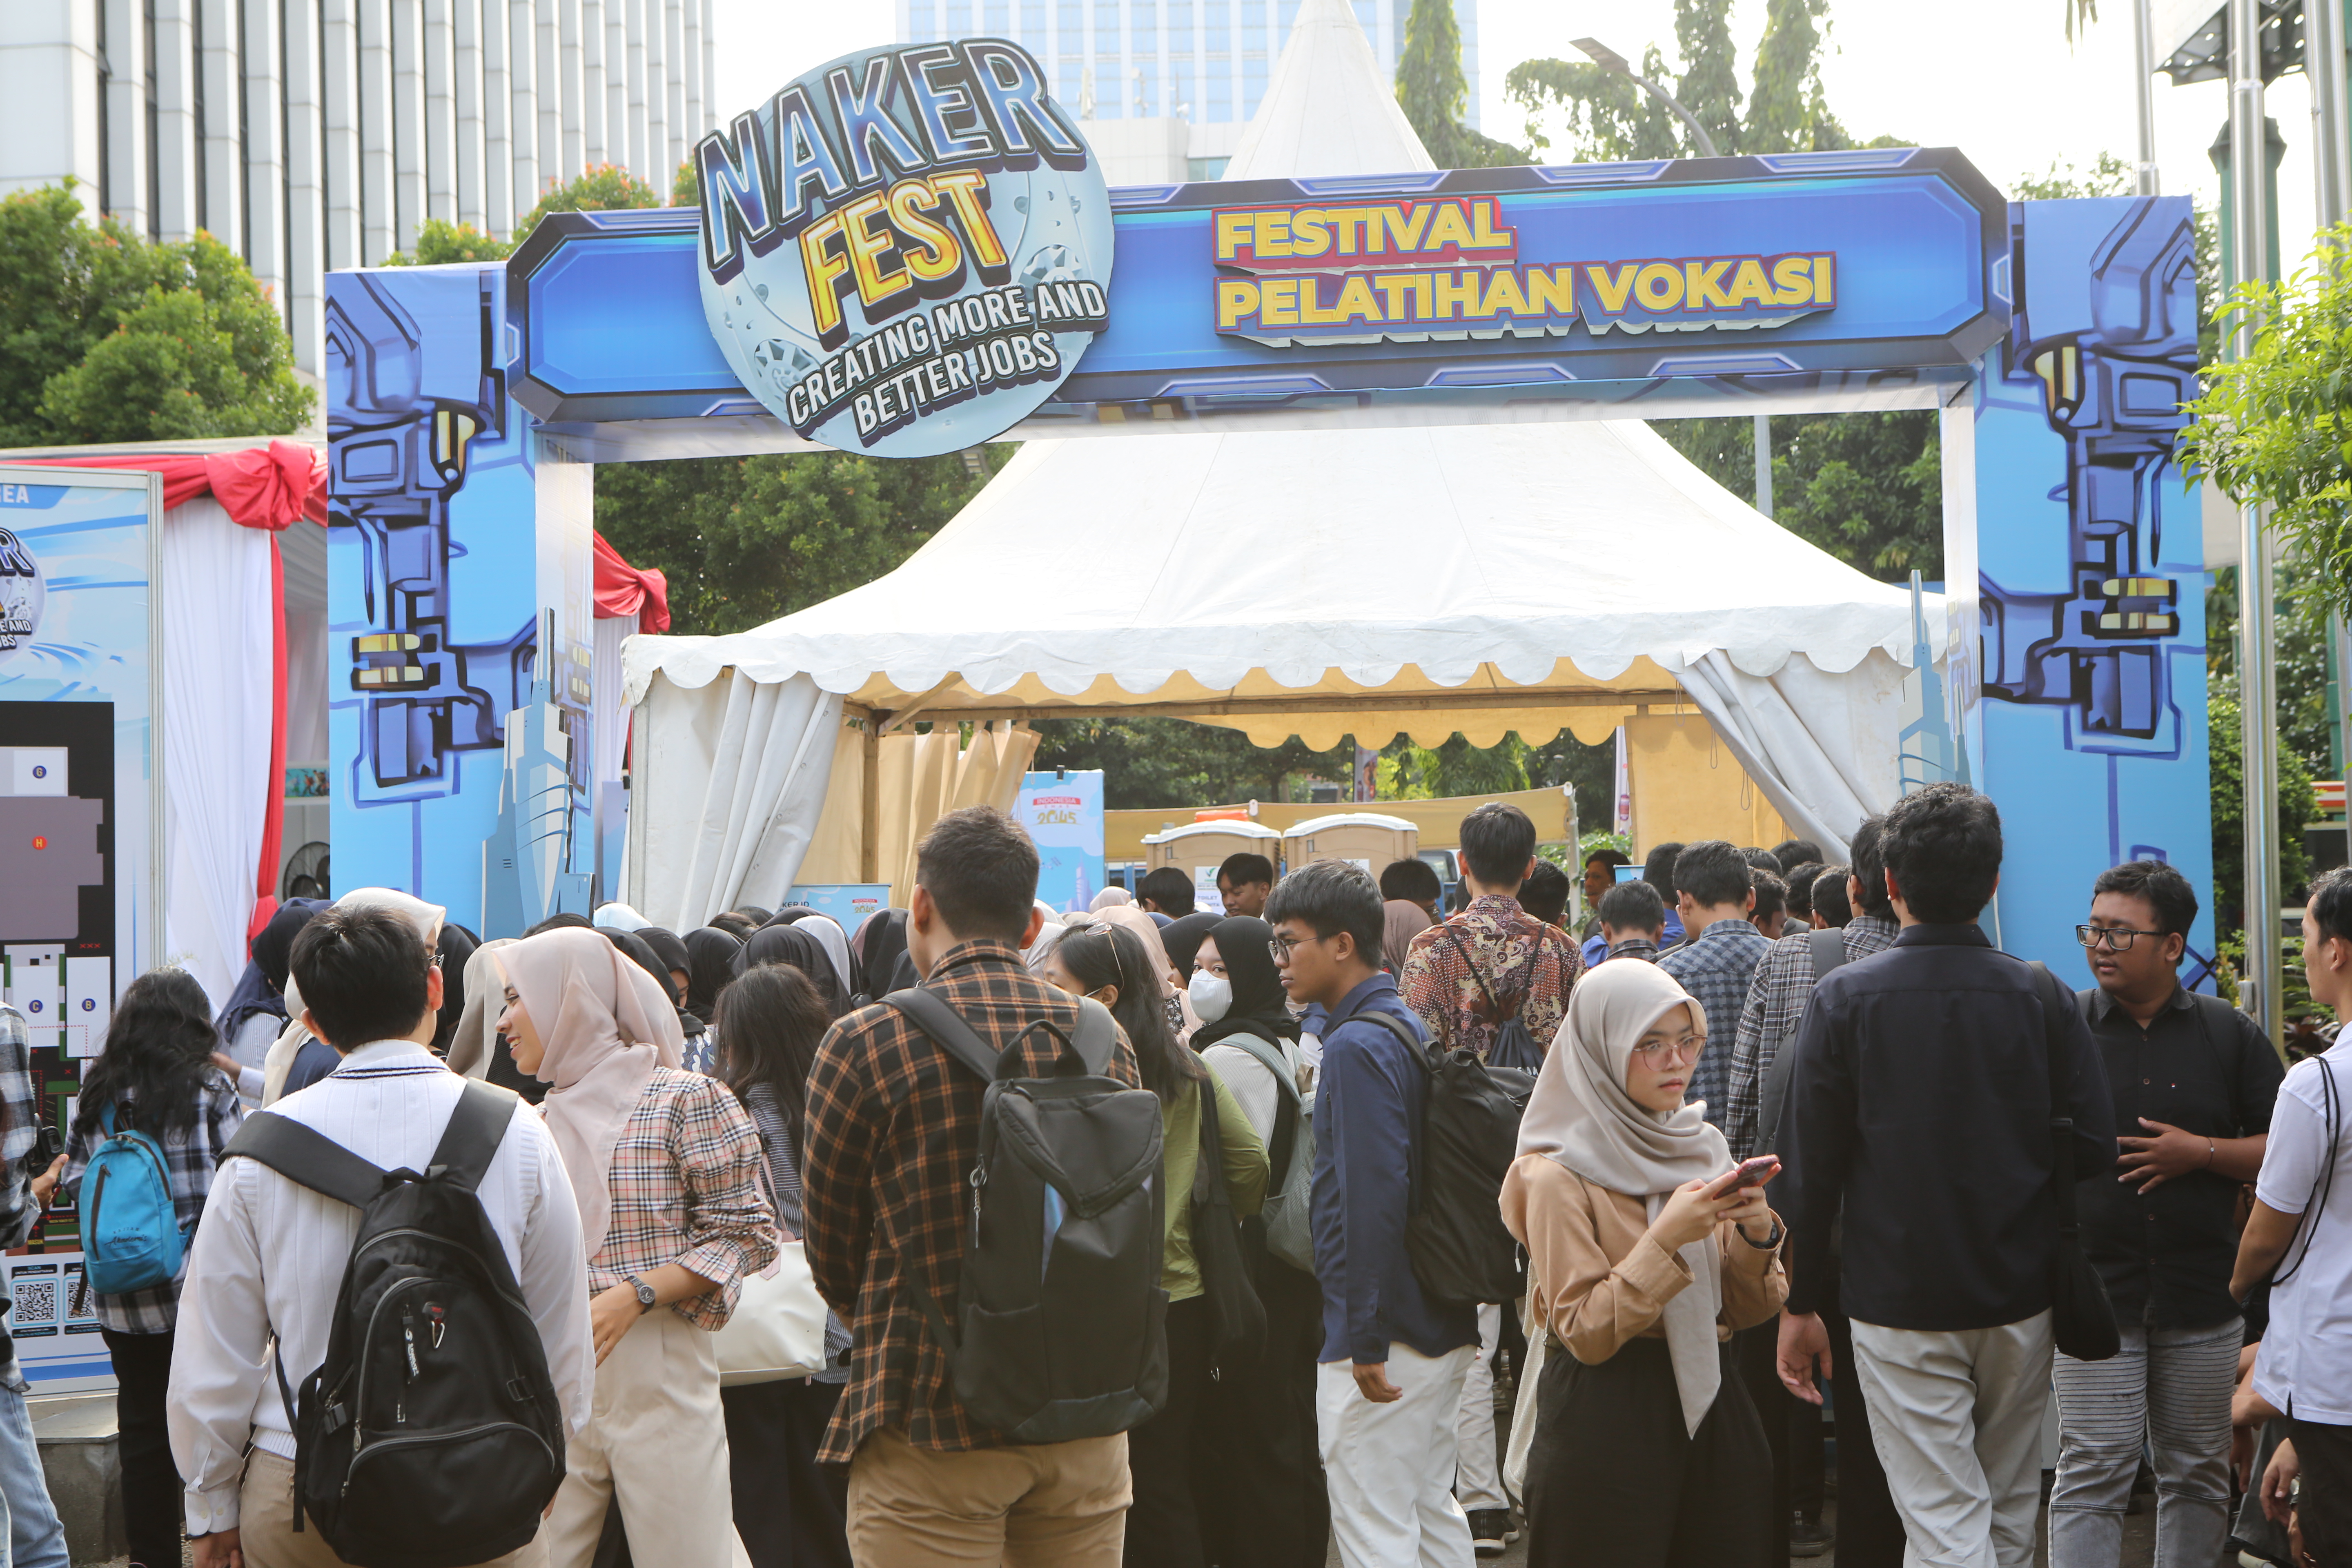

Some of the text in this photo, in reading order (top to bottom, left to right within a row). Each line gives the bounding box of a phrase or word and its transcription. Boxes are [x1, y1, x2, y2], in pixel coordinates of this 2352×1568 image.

[695, 38, 1085, 274] NAKER
[1218, 202, 1513, 259] FESTIVAL
[800, 169, 1007, 337] FEST
[1219, 256, 1833, 328] PELATIHAN VOKASI
[788, 282, 1106, 427] CREATING MORE AND
[853, 331, 1058, 436] BETTER JOBS
[0, 484, 30, 503] EA
[8, 620, 32, 633] AND
[0, 634, 16, 647] BS
[36, 768, 43, 777] G
[1037, 810, 1077, 824] 2045
[36, 838, 42, 847] H
[32, 1002, 39, 1011] C
[85, 1000, 92, 1009] B
